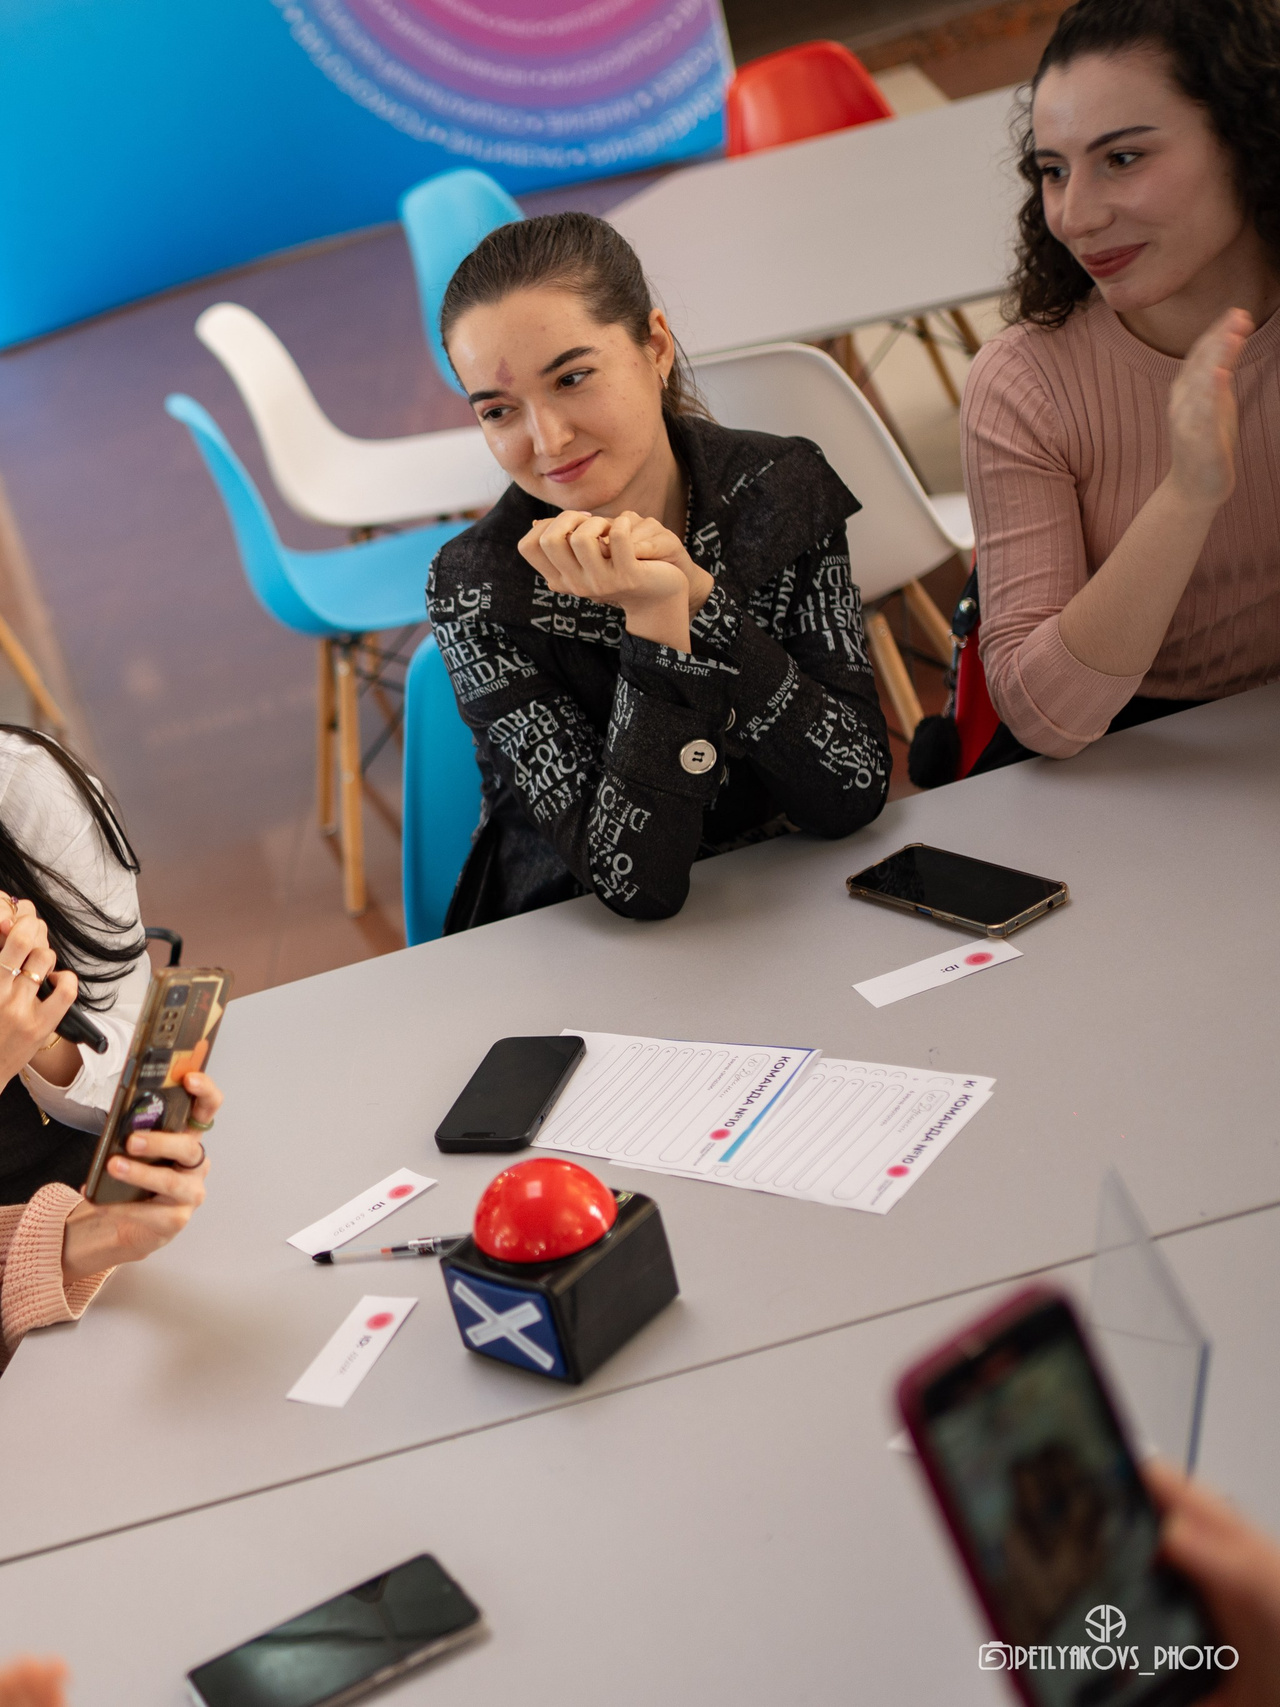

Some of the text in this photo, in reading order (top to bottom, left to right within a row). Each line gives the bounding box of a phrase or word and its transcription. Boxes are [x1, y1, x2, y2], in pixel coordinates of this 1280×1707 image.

[724, 1055, 791, 1128] КОМАНДА №10
[902, 1094, 974, 1164] КОМАНДА №10
